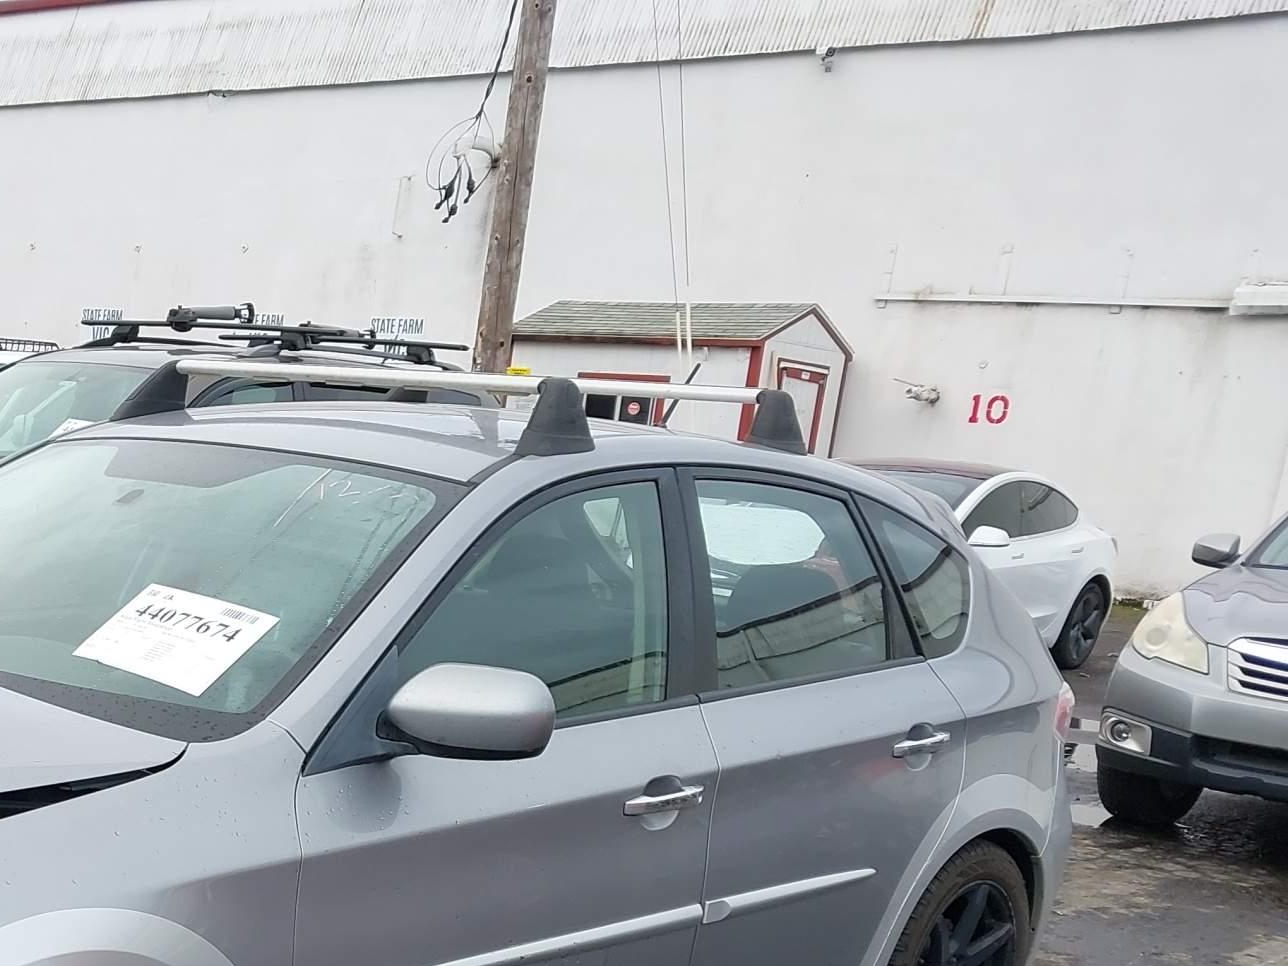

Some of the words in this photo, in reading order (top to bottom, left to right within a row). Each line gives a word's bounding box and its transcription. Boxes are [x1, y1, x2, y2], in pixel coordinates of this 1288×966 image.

[82, 308, 102, 321] STATE
[103, 309, 124, 321] FARM
[261, 314, 285, 326] FARM
[371, 318, 397, 334] STATE
[398, 319, 425, 335] FARM
[968, 394, 1010, 425] 10
[135, 603, 243, 643] 44077674
